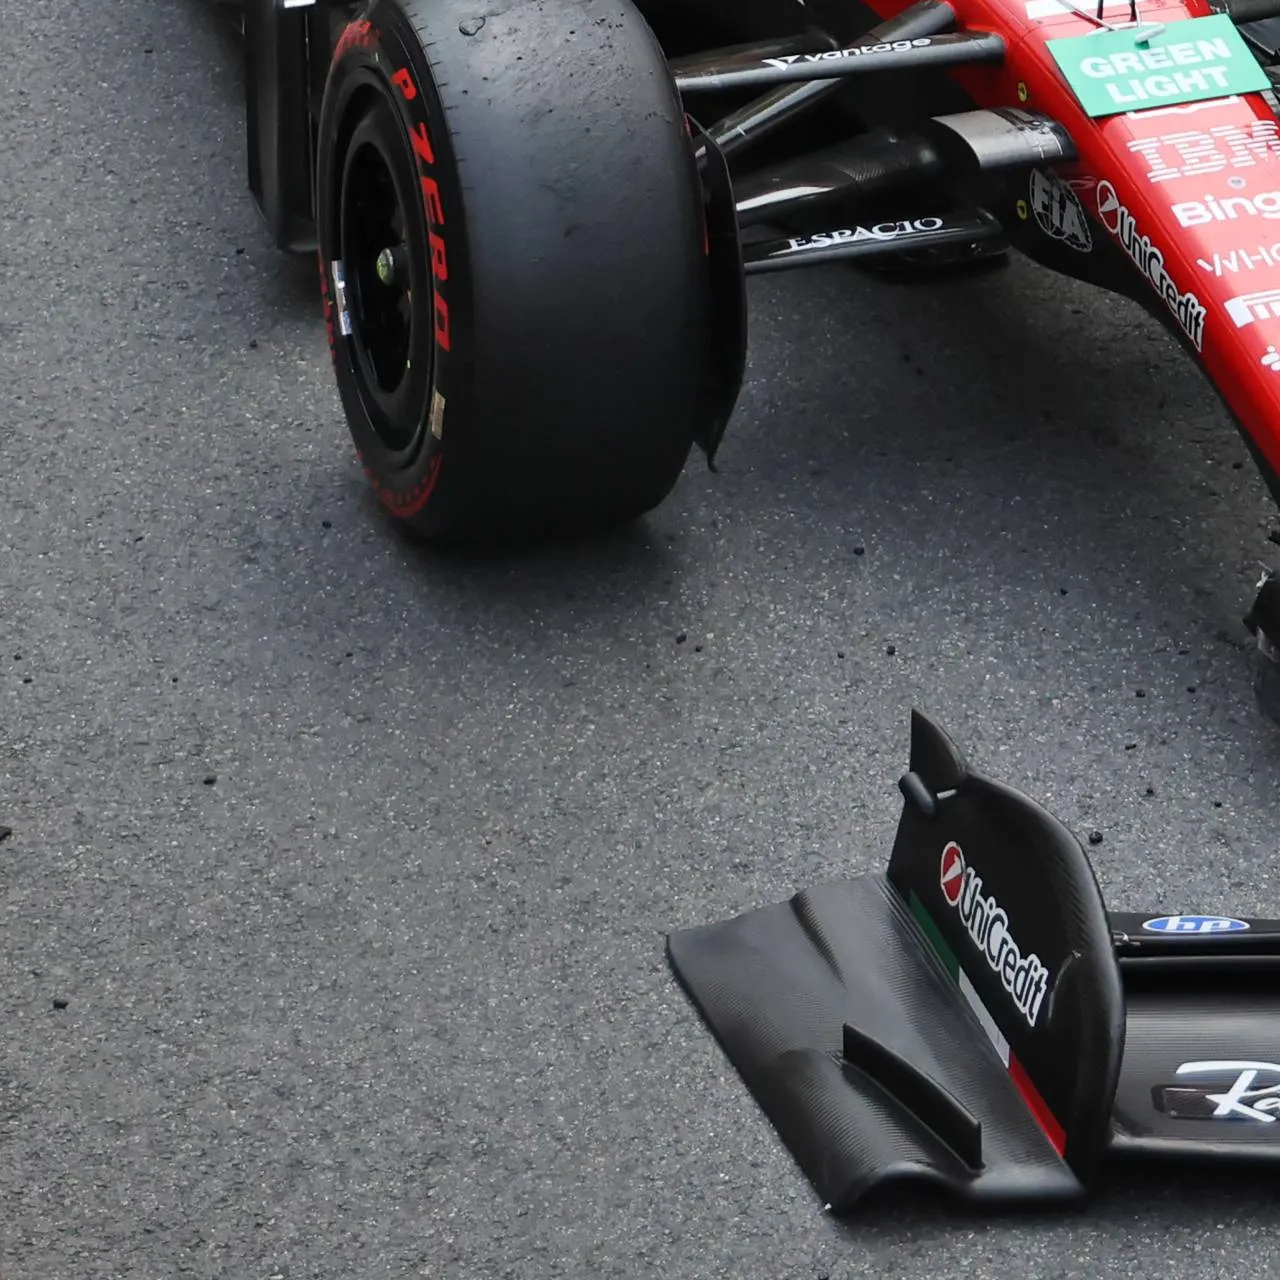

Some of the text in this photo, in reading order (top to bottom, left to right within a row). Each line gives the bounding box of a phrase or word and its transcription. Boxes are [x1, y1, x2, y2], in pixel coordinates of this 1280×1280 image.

[805, 36, 932, 65] vantage
[1080, 38, 1232, 79] GREEN
[1105, 65, 1230, 104] LIGHT
[408, 121, 451, 353] ZERO
[787, 217, 944, 251] ESPACIO
[1118, 205, 1207, 351] UniCredit
[960, 866, 1051, 1027] UniCredit
